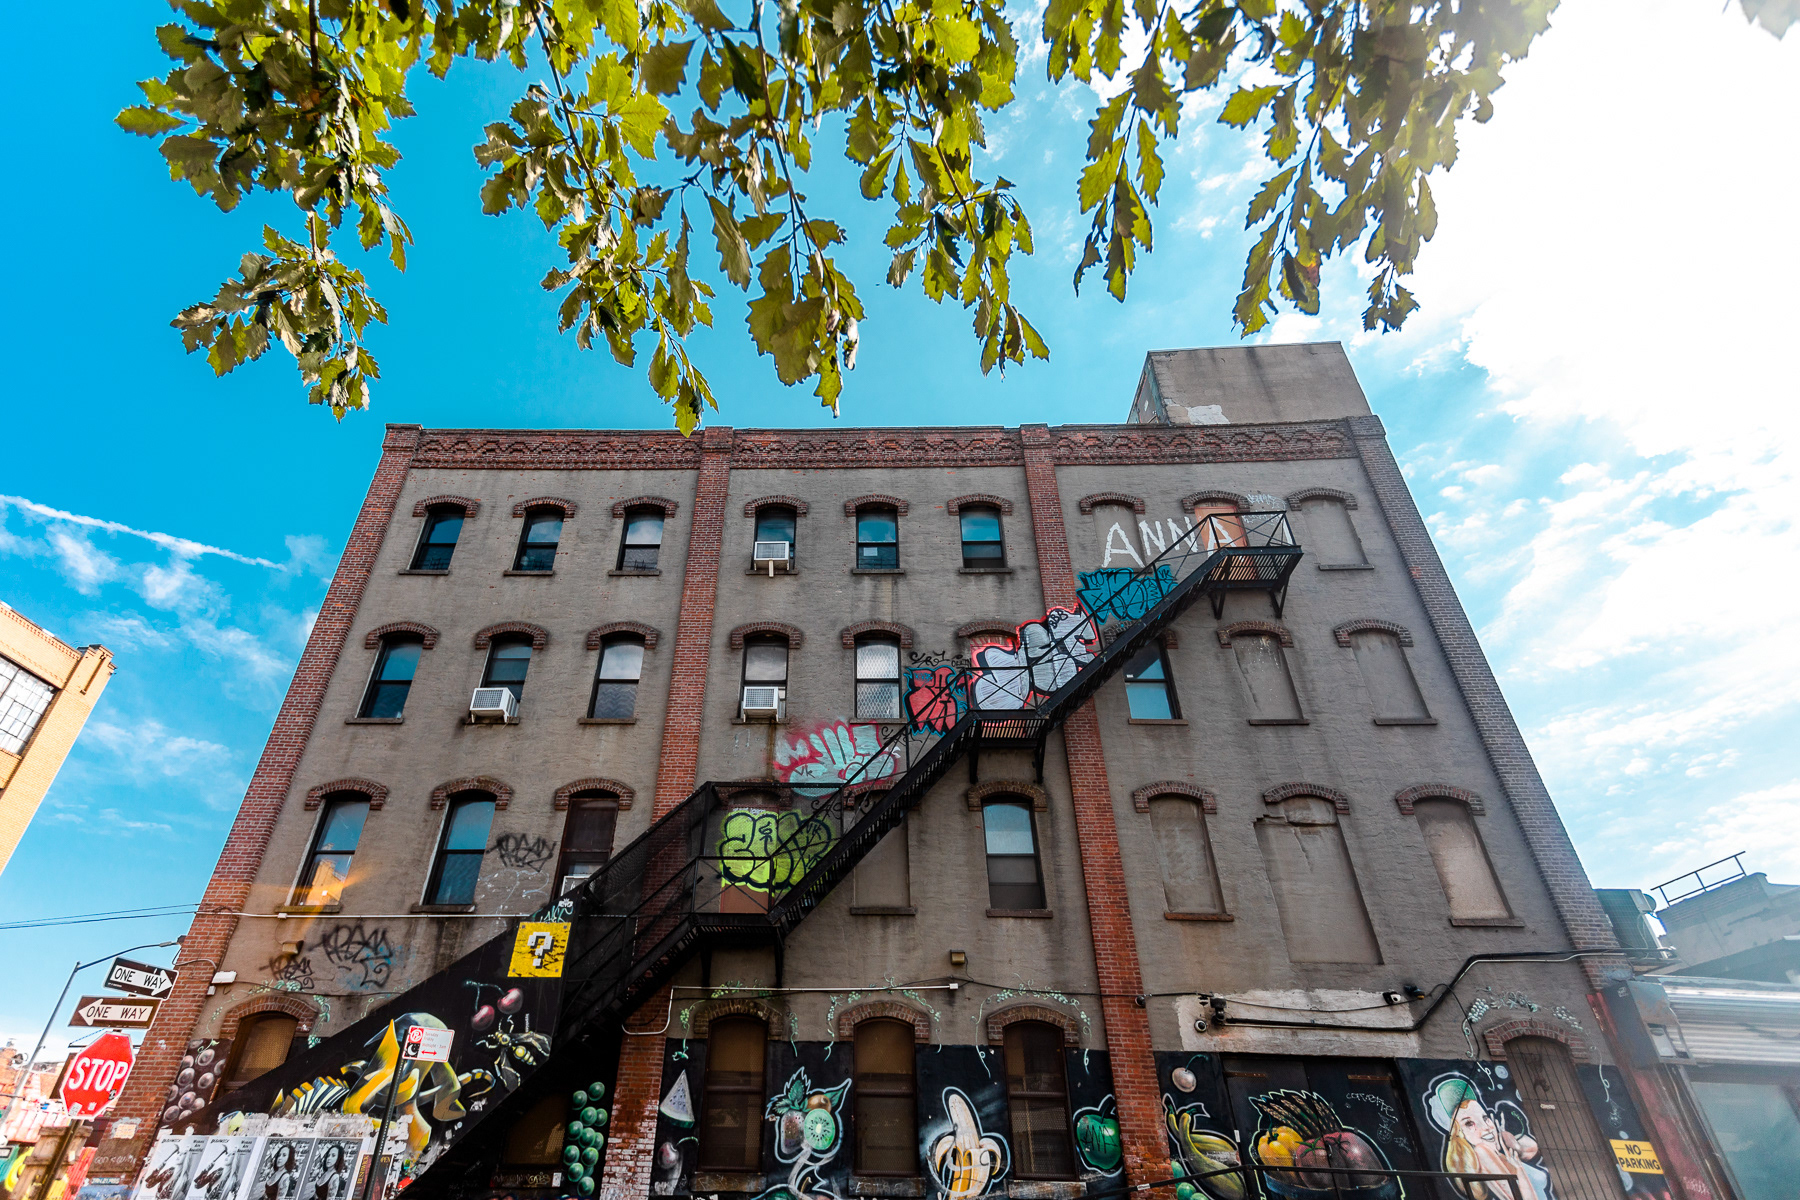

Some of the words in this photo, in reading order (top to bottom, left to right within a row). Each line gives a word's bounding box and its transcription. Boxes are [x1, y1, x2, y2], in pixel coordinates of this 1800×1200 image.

[114, 967, 136, 983] ONE
[143, 974, 167, 989] WAY
[86, 1005, 112, 1019] ONE
[120, 1007, 147, 1020] WAY
[68, 1057, 129, 1092] STOP
[1625, 1144, 1642, 1156] NO
[1618, 1157, 1661, 1171] PARKING
